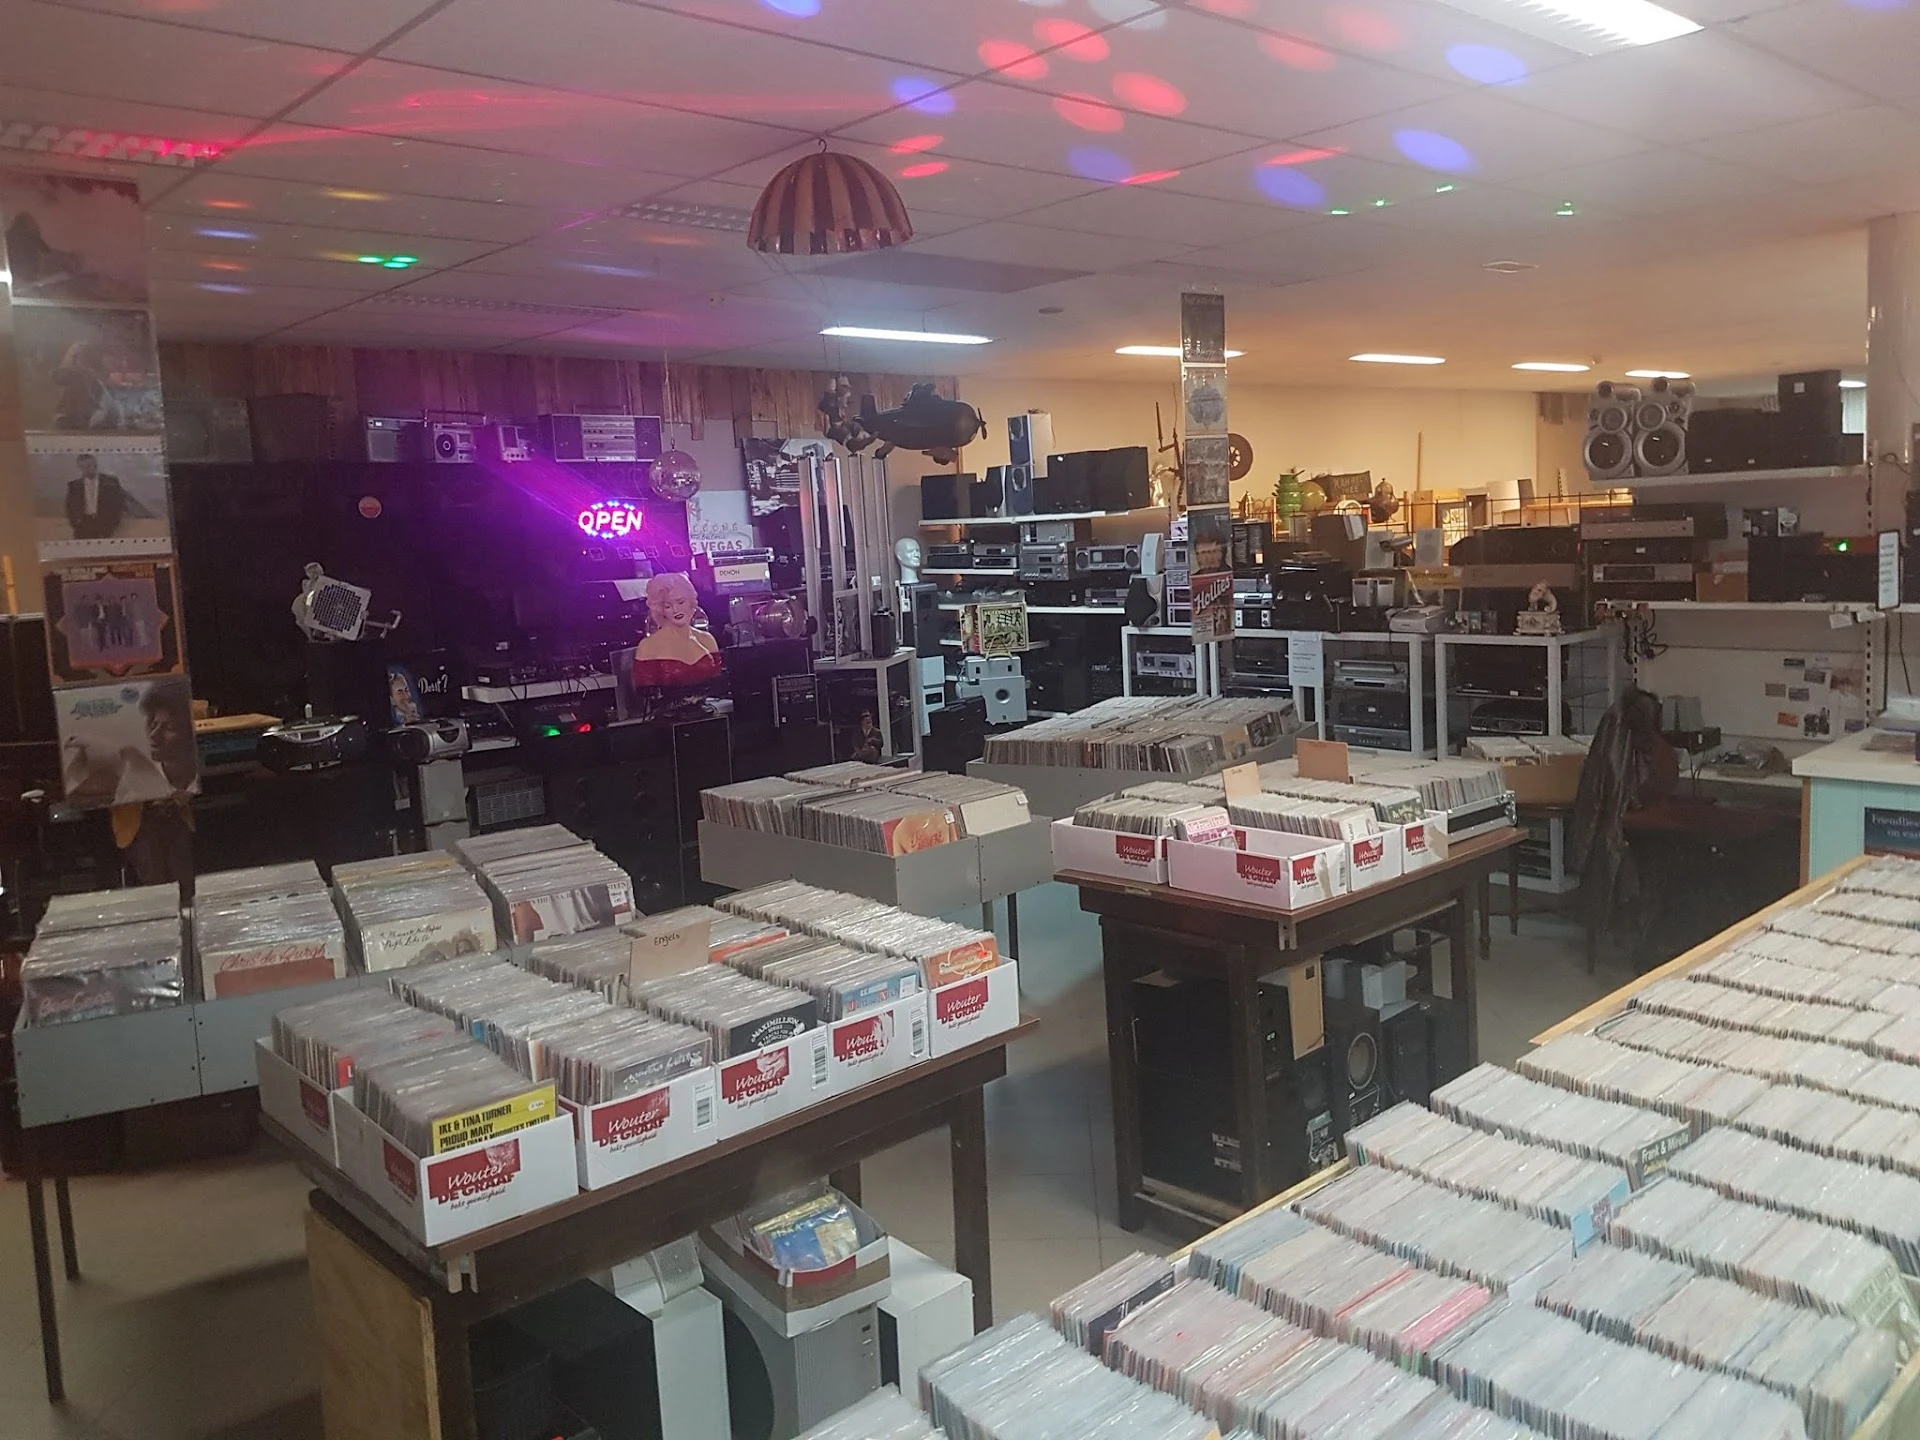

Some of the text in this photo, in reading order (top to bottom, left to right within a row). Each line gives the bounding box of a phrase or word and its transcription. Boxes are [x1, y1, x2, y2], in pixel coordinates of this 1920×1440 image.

[578, 511, 643, 531] OPEN
[692, 522, 739, 532] LCOME
[700, 540, 743, 551] VEGAS
[719, 569, 740, 577] DENON
[1194, 577, 1231, 615] Hollies
[1123, 845, 1149, 856] Wouter
[1244, 865, 1273, 877] Wouter
[653, 933, 680, 946] Engels
[220, 953, 254, 974] Chris
[947, 994, 981, 1013] Wouter
[941, 1014, 953, 1024] DE
[846, 1033, 876, 1050] Wout
[840, 1050, 854, 1062] DE
[736, 1067, 777, 1091] Wouter
[729, 1091, 744, 1104] DE
[439, 1123, 452, 1135] IKE
[453, 1121, 460, 1131] &
[461, 1114, 480, 1129] TINA
[481, 1104, 512, 1121] TURNER
[608, 1108, 659, 1133] Wouter
[440, 1122, 494, 1148] PROUD MARY
[599, 1119, 665, 1147] DE GRAAF
[1641, 1144, 1659, 1164] Frank
[1660, 1140, 1667, 1155] &
[448, 1161, 507, 1191] Wouter
[438, 1173, 515, 1205] DE GRAAF
